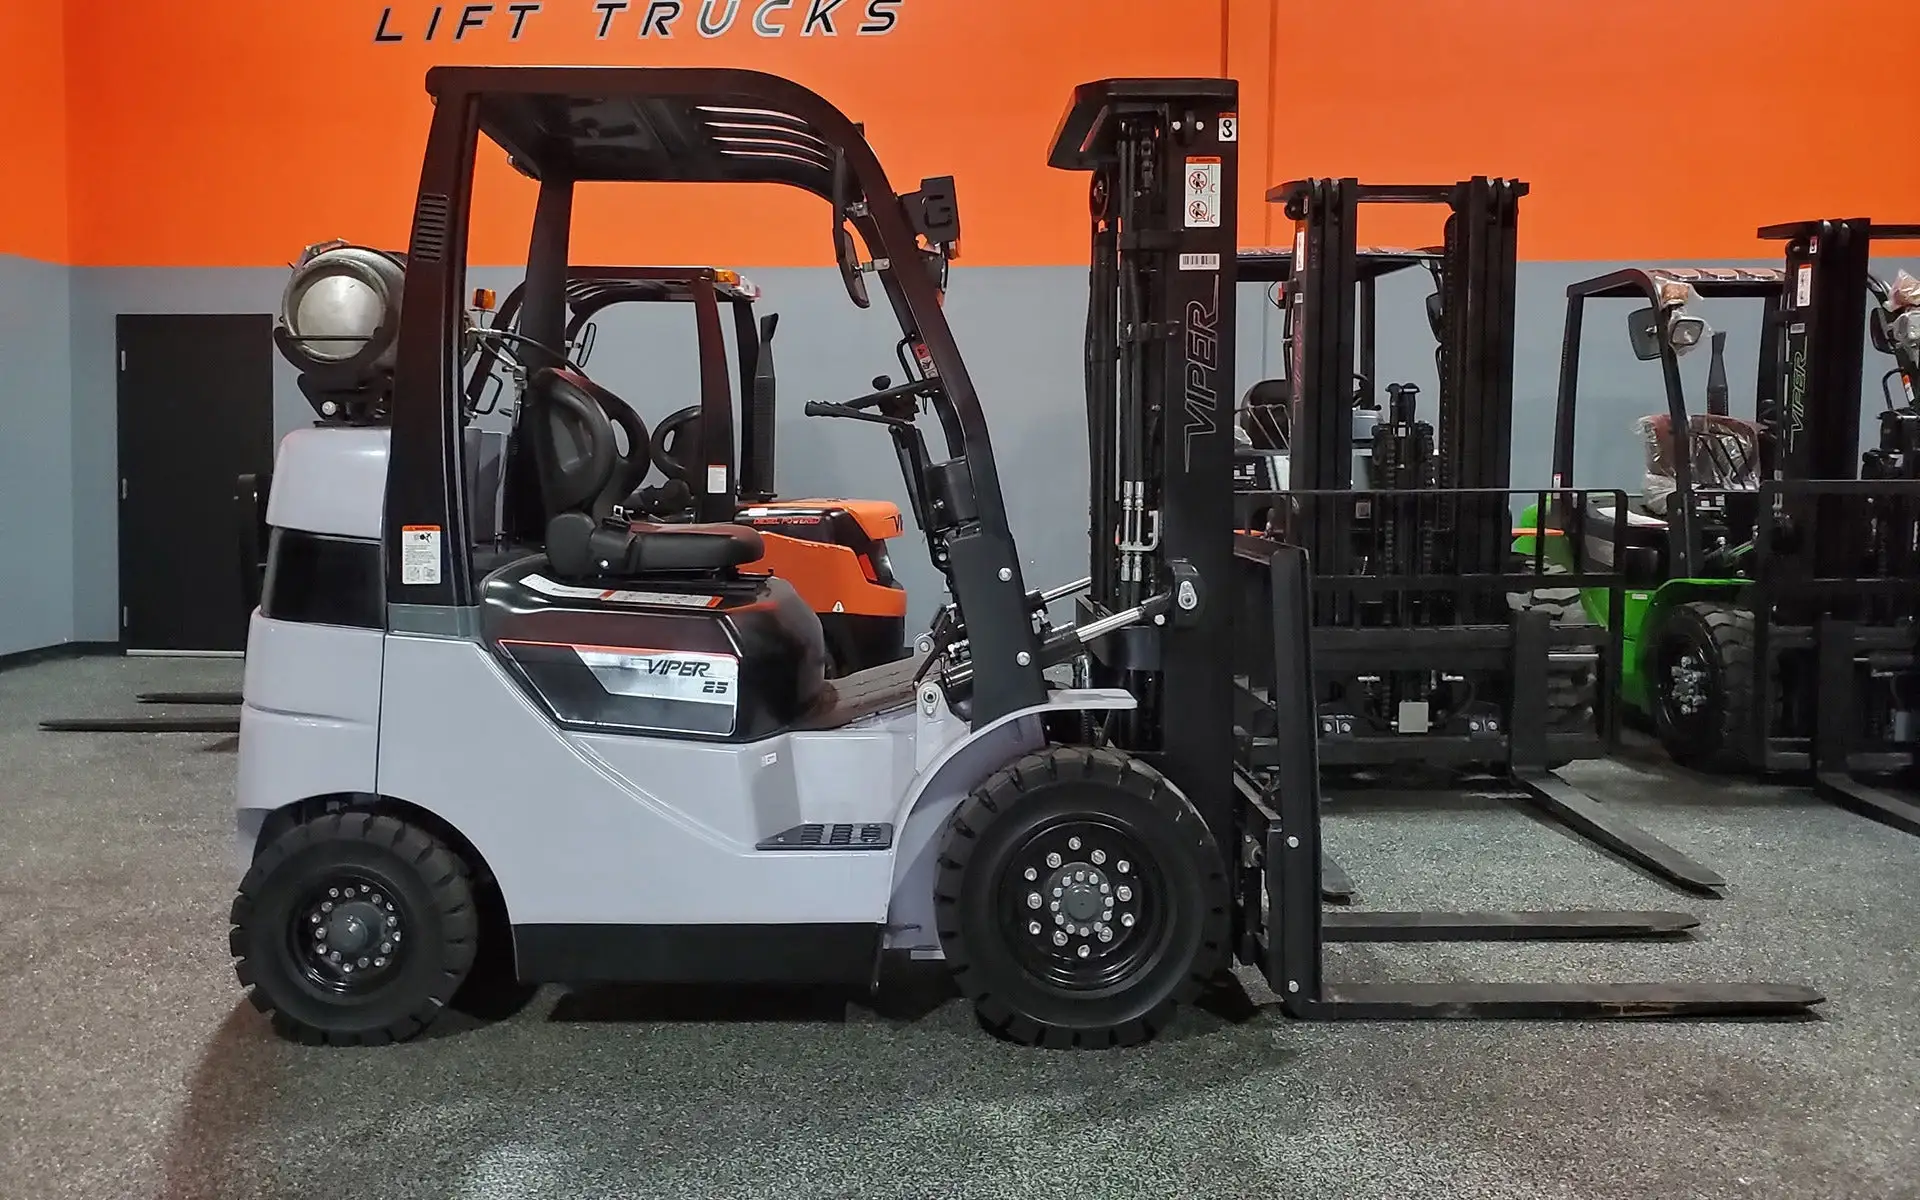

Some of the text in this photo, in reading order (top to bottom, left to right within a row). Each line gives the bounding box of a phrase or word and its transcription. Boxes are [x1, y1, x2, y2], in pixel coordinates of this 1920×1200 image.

[374, 0, 902, 43] LIFT TRUCKS
[1184, 274, 1220, 473] VIPER
[1790, 336, 1808, 454] VIPER
[631, 658, 720, 678] VIPER
[702, 681, 729, 694] 25
